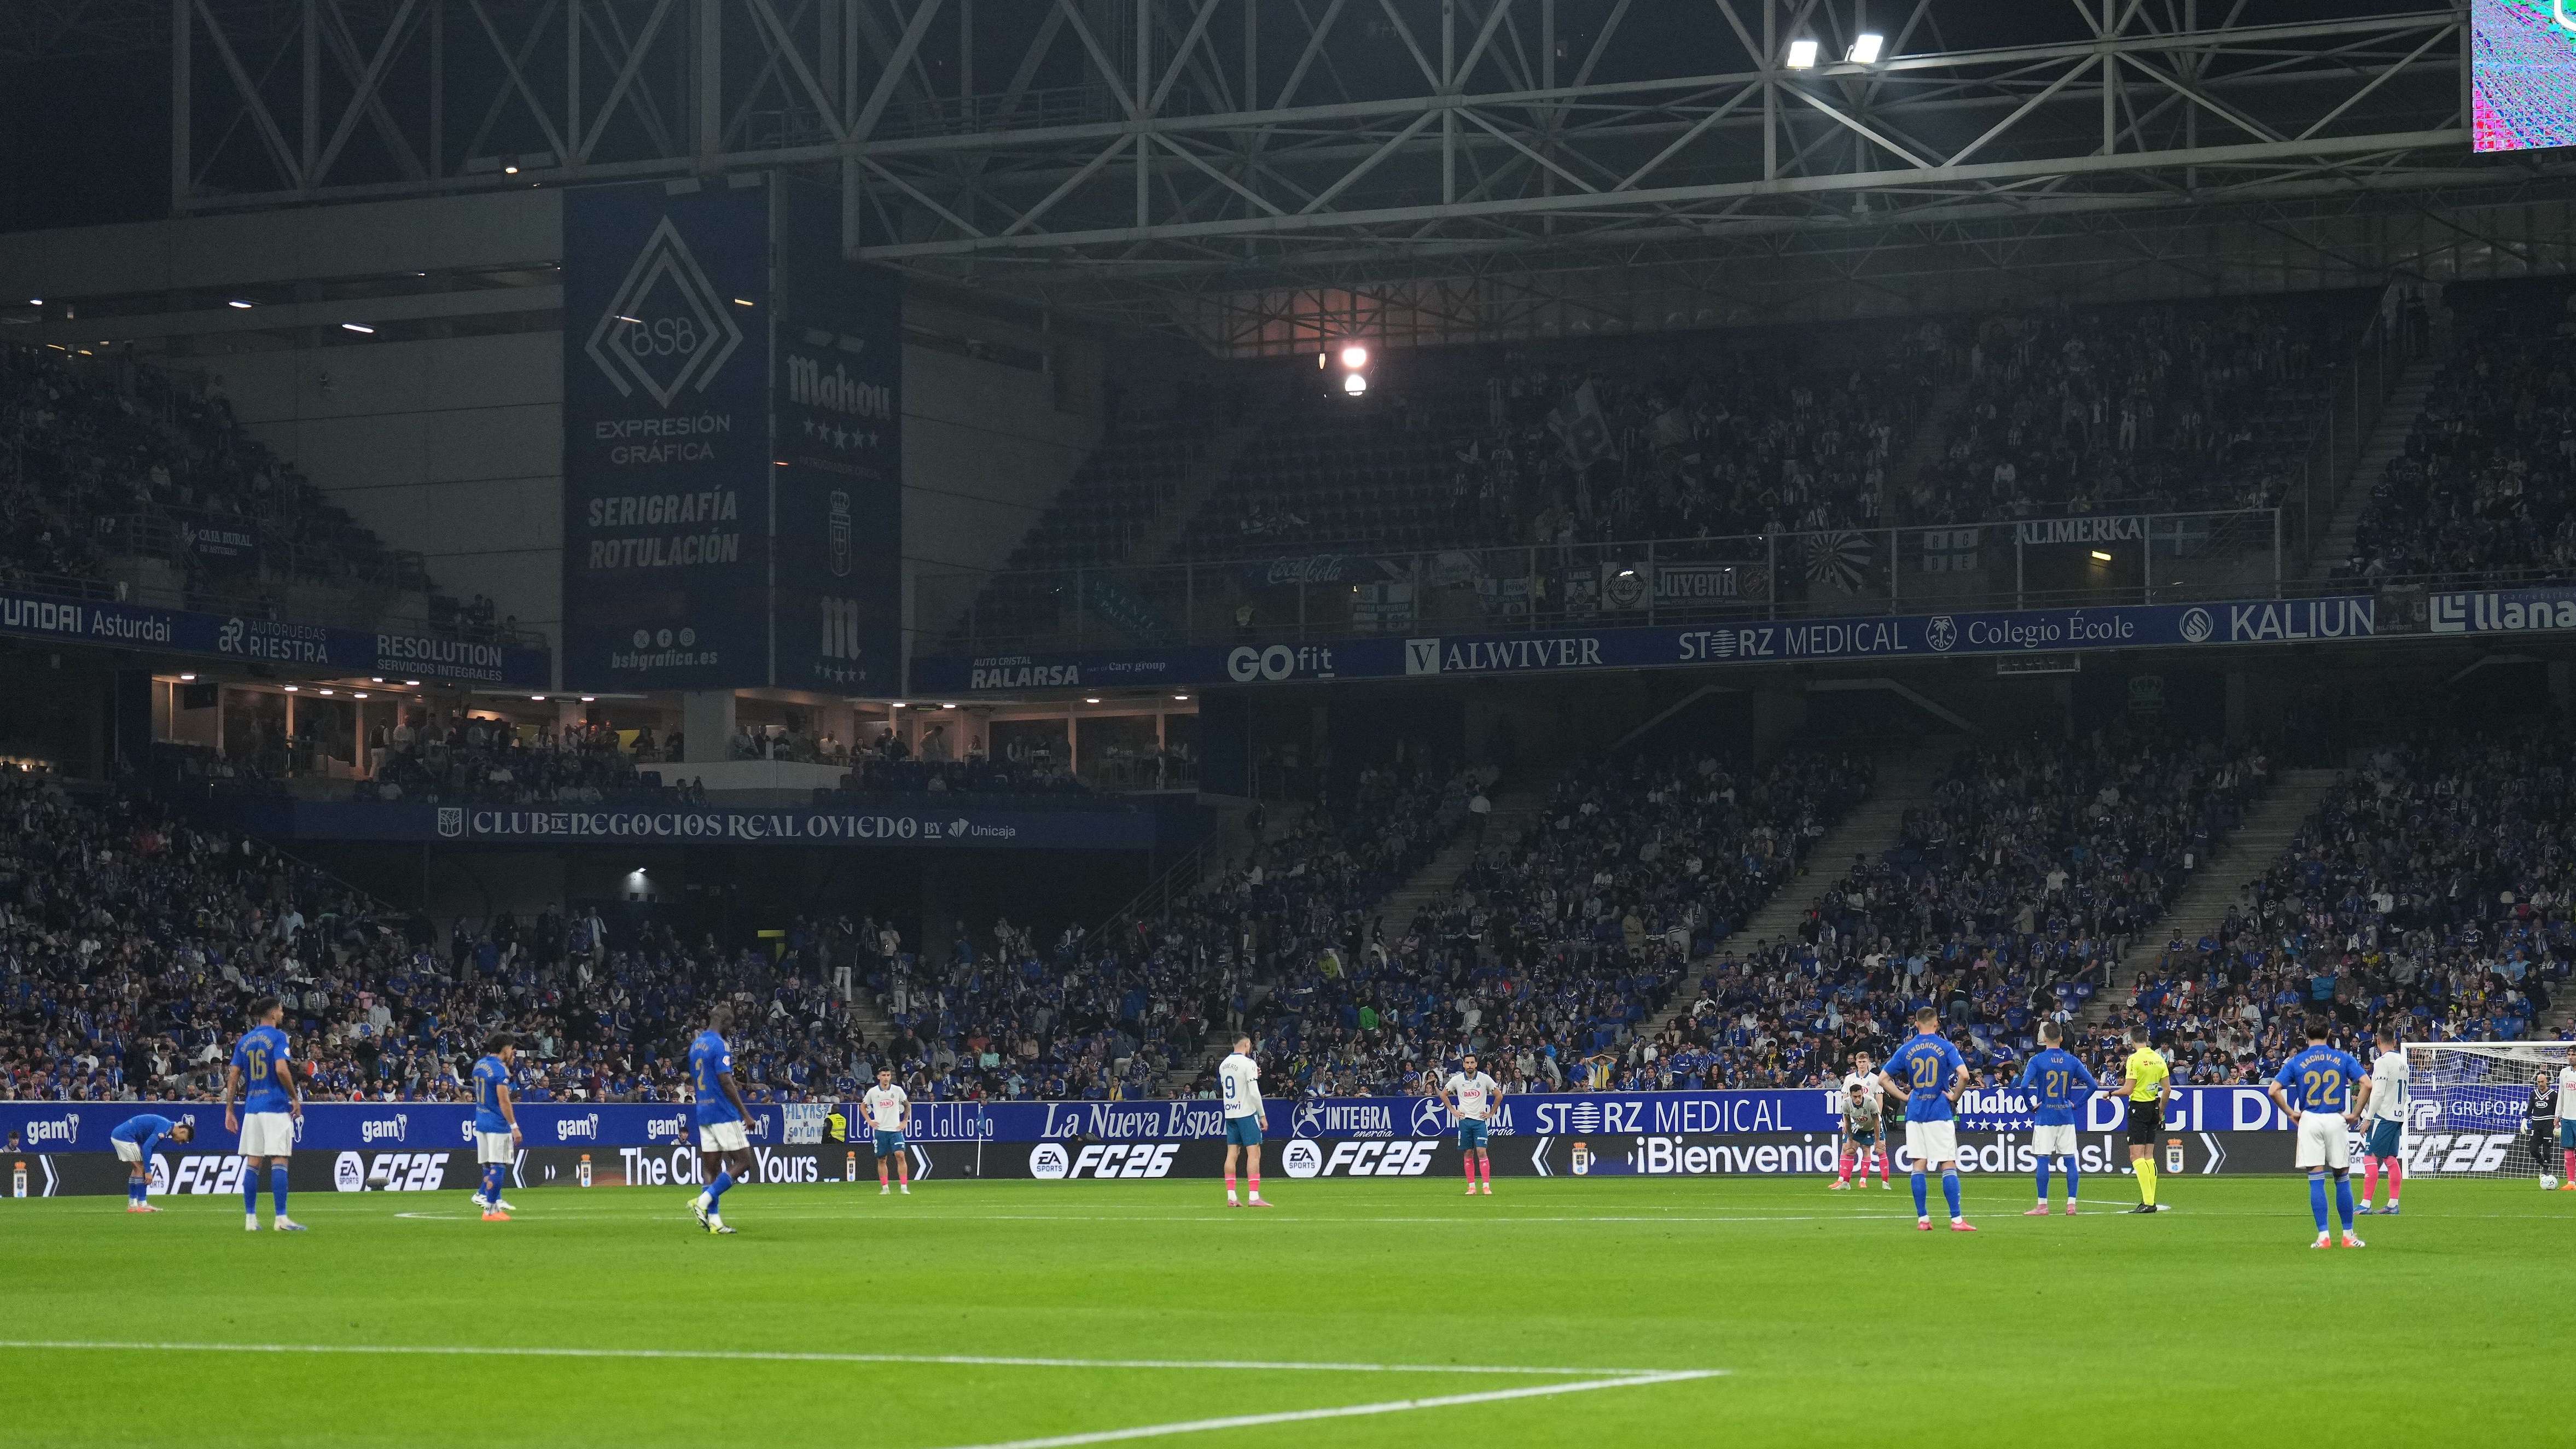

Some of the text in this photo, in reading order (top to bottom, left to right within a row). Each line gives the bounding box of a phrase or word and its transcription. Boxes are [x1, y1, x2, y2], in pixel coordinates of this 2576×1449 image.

[787, 354, 890, 421] Mahou
[596, 412, 730, 439] EXPRESIÓN
[610, 438, 714, 464] GRÁFICA
[588, 484, 738, 527] SERIGRAFÍA
[199, 529, 253, 547] CAJA RURAL
[588, 528, 739, 569] ROTULACIÓN
[0, 597, 171, 643] UNDAI Asturdai
[251, 620, 327, 642] AUTORUEDAS
[1969, 609, 2134, 649] Colegio École
[2230, 599, 2375, 641] KALIUN
[249, 635, 328, 665] RIESTRA
[377, 634, 502, 667] RESOLUTION
[1786, 622, 1909, 655] MEDICAL
[611, 650, 718, 672] bsbgrafica.es
[973, 656, 1032, 667] AUTO CRISTAL
[1108, 661, 1134, 673] Cary
[1135, 660, 1166, 673] group
[1443, 637, 1603, 672] ALWIVER
[377, 658, 503, 682] SERVICIOS INTEGRALES
[970, 665, 1080, 689] RALARSA
[473, 811, 549, 835] CLUB
[570, 813, 721, 837] NEGOCIOS
[728, 814, 801, 840] REAL
[806, 814, 918, 839] OVIEDO
[924, 821, 943, 836] BY
[971, 825, 1016, 840] Unicaja
[247, 1049, 267, 1081] 16
[1911, 1056, 1938, 1089] 20
[2300, 1054, 2325, 1069] NACHO
[1225, 1075, 1235, 1099] 9
[2045, 1070, 2069, 1098] 21
[2304, 1069, 2341, 1106] 22
[931, 1103, 993, 1138] Colloo
[1040, 1102, 1227, 1139] La Nueva Espa
[1326, 1105, 1392, 1130] INTEGRA
[1655, 1099, 1793, 1133] MEDICAL
[2087, 1090, 2203, 1132] DGI
[2451, 1101, 2528, 1116] GRUPO PA
[27, 1120, 68, 1145] gam
[362, 1120, 398, 1143] gam
[557, 1119, 591, 1141] gam
[1353, 1128, 1394, 1138] energía
[340, 1160, 358, 1176] EA
[619, 1147, 667, 1186] The
[754, 1147, 818, 1184] Yours
[1037, 1151, 1061, 1165] EA
[1068, 1143, 1181, 1179] FC26
[1290, 1147, 1314, 1161] EA
[1322, 1140, 1440, 1176] FC26
